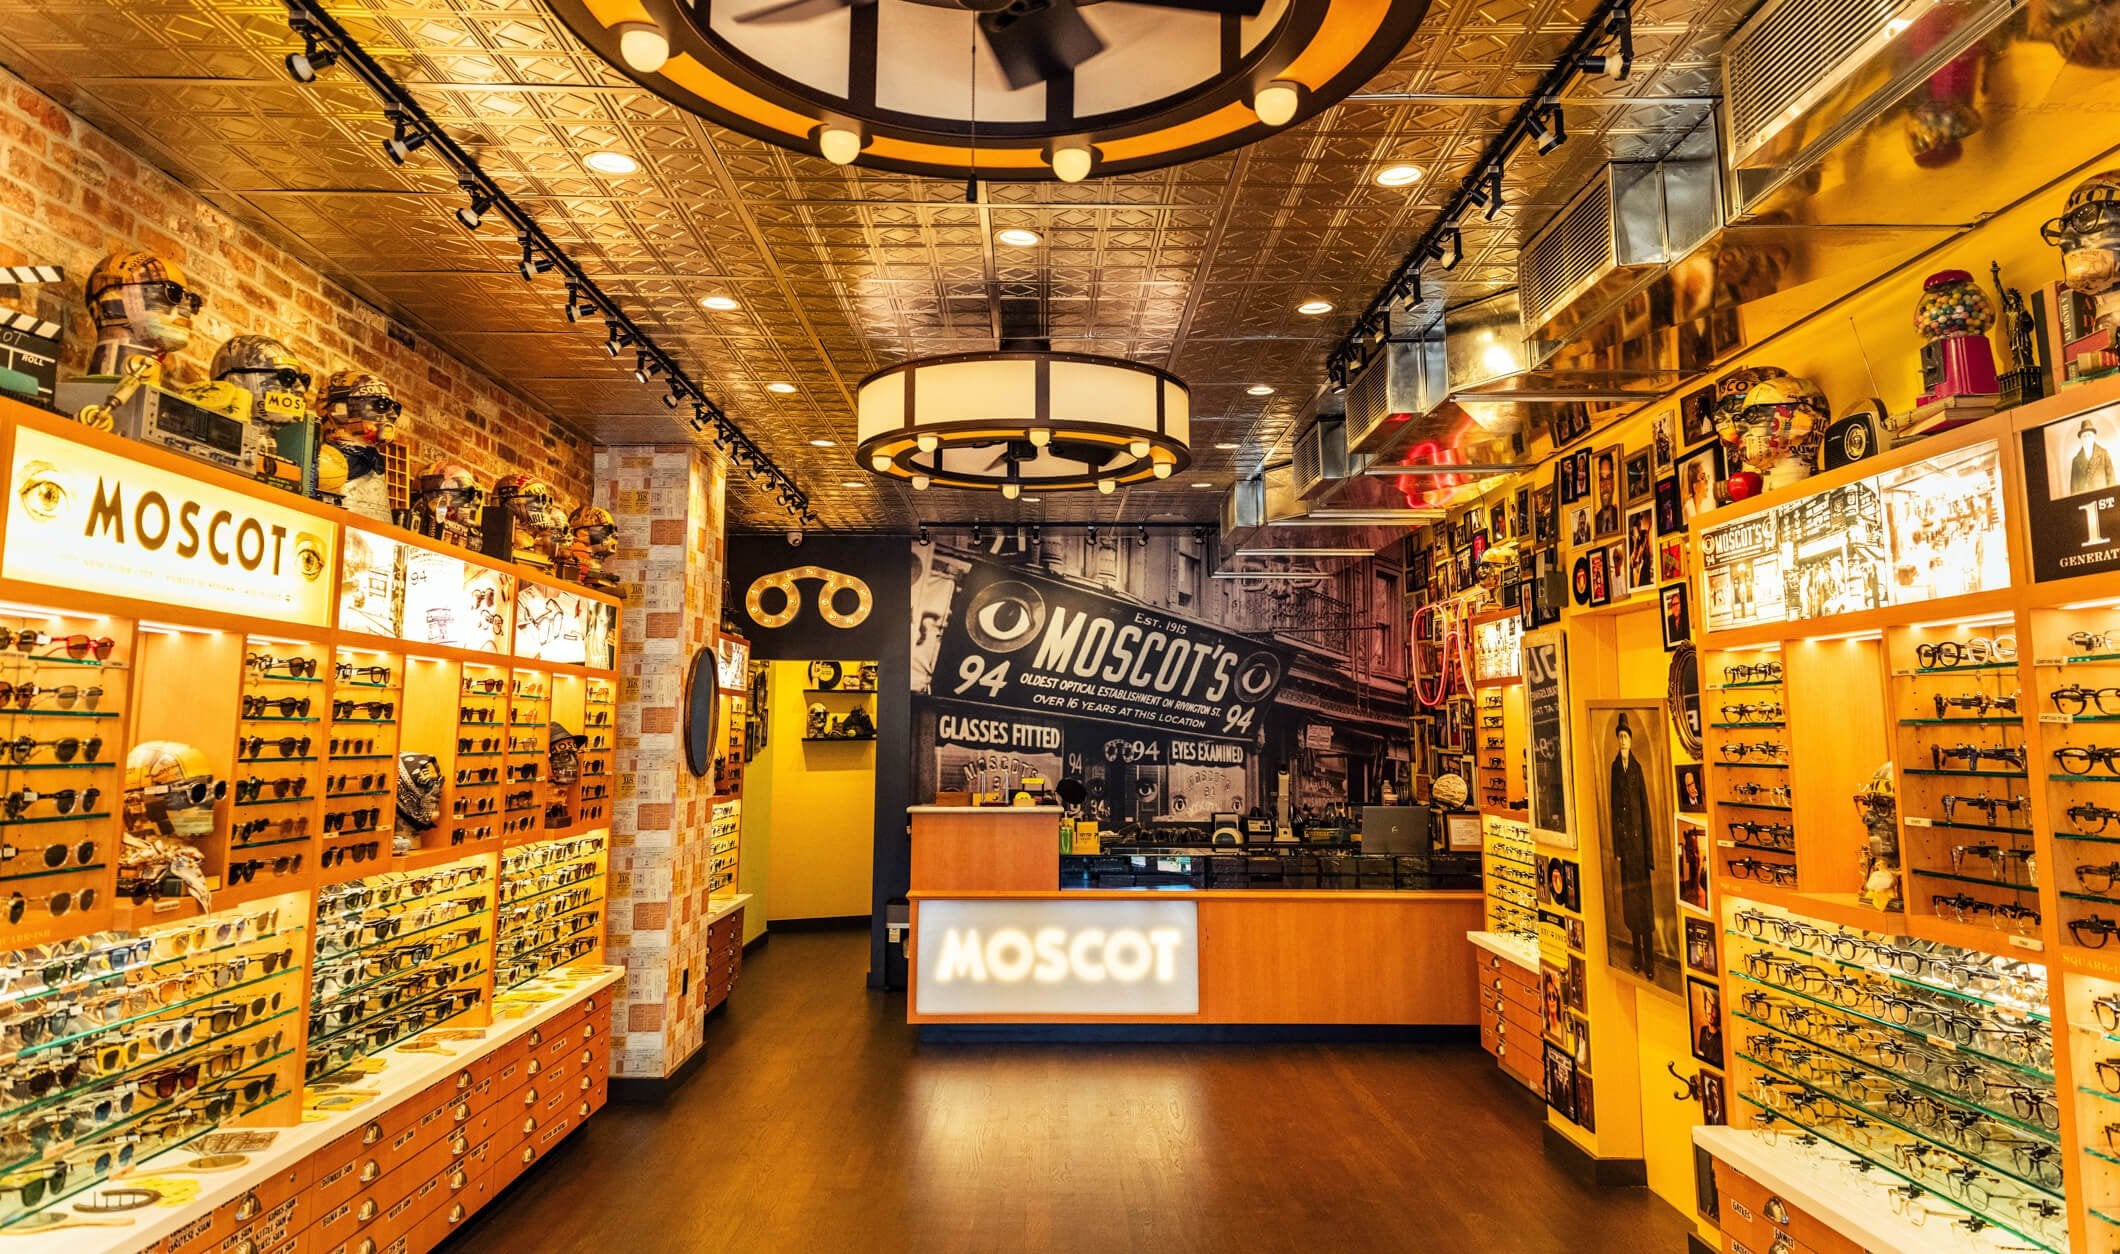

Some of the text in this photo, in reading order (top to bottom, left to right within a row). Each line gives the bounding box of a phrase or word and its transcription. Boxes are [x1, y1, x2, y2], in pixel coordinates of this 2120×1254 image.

[21, 353, 46, 367] ROLL
[84, 475, 288, 577] MOSCOT
[1715, 522, 1763, 555] MOSCOT'S
[1166, 620, 1188, 635] 1915
[1032, 606, 1239, 703] MOSCOT'S
[953, 654, 1011, 698] 94
[1020, 673, 1059, 689] OLDEST
[1059, 678, 1097, 696] OPTICAL
[1097, 685, 1161, 706] ESTABLISHMENT
[1162, 697, 1175, 708] ON
[1175, 700, 1211, 716] RIVINGTON
[1033, 694, 1207, 728] OVER 16 YEARS AT THIS LOCATION
[940, 715, 1060, 749] GLASSES FITTED
[1222, 704, 1257, 735] 94
[1068, 753, 1082, 775] 94
[1132, 740, 1160, 762] 94
[1172, 740, 1244, 763] EYES EXAMINED
[935, 927, 1182, 983] MOSCOT
